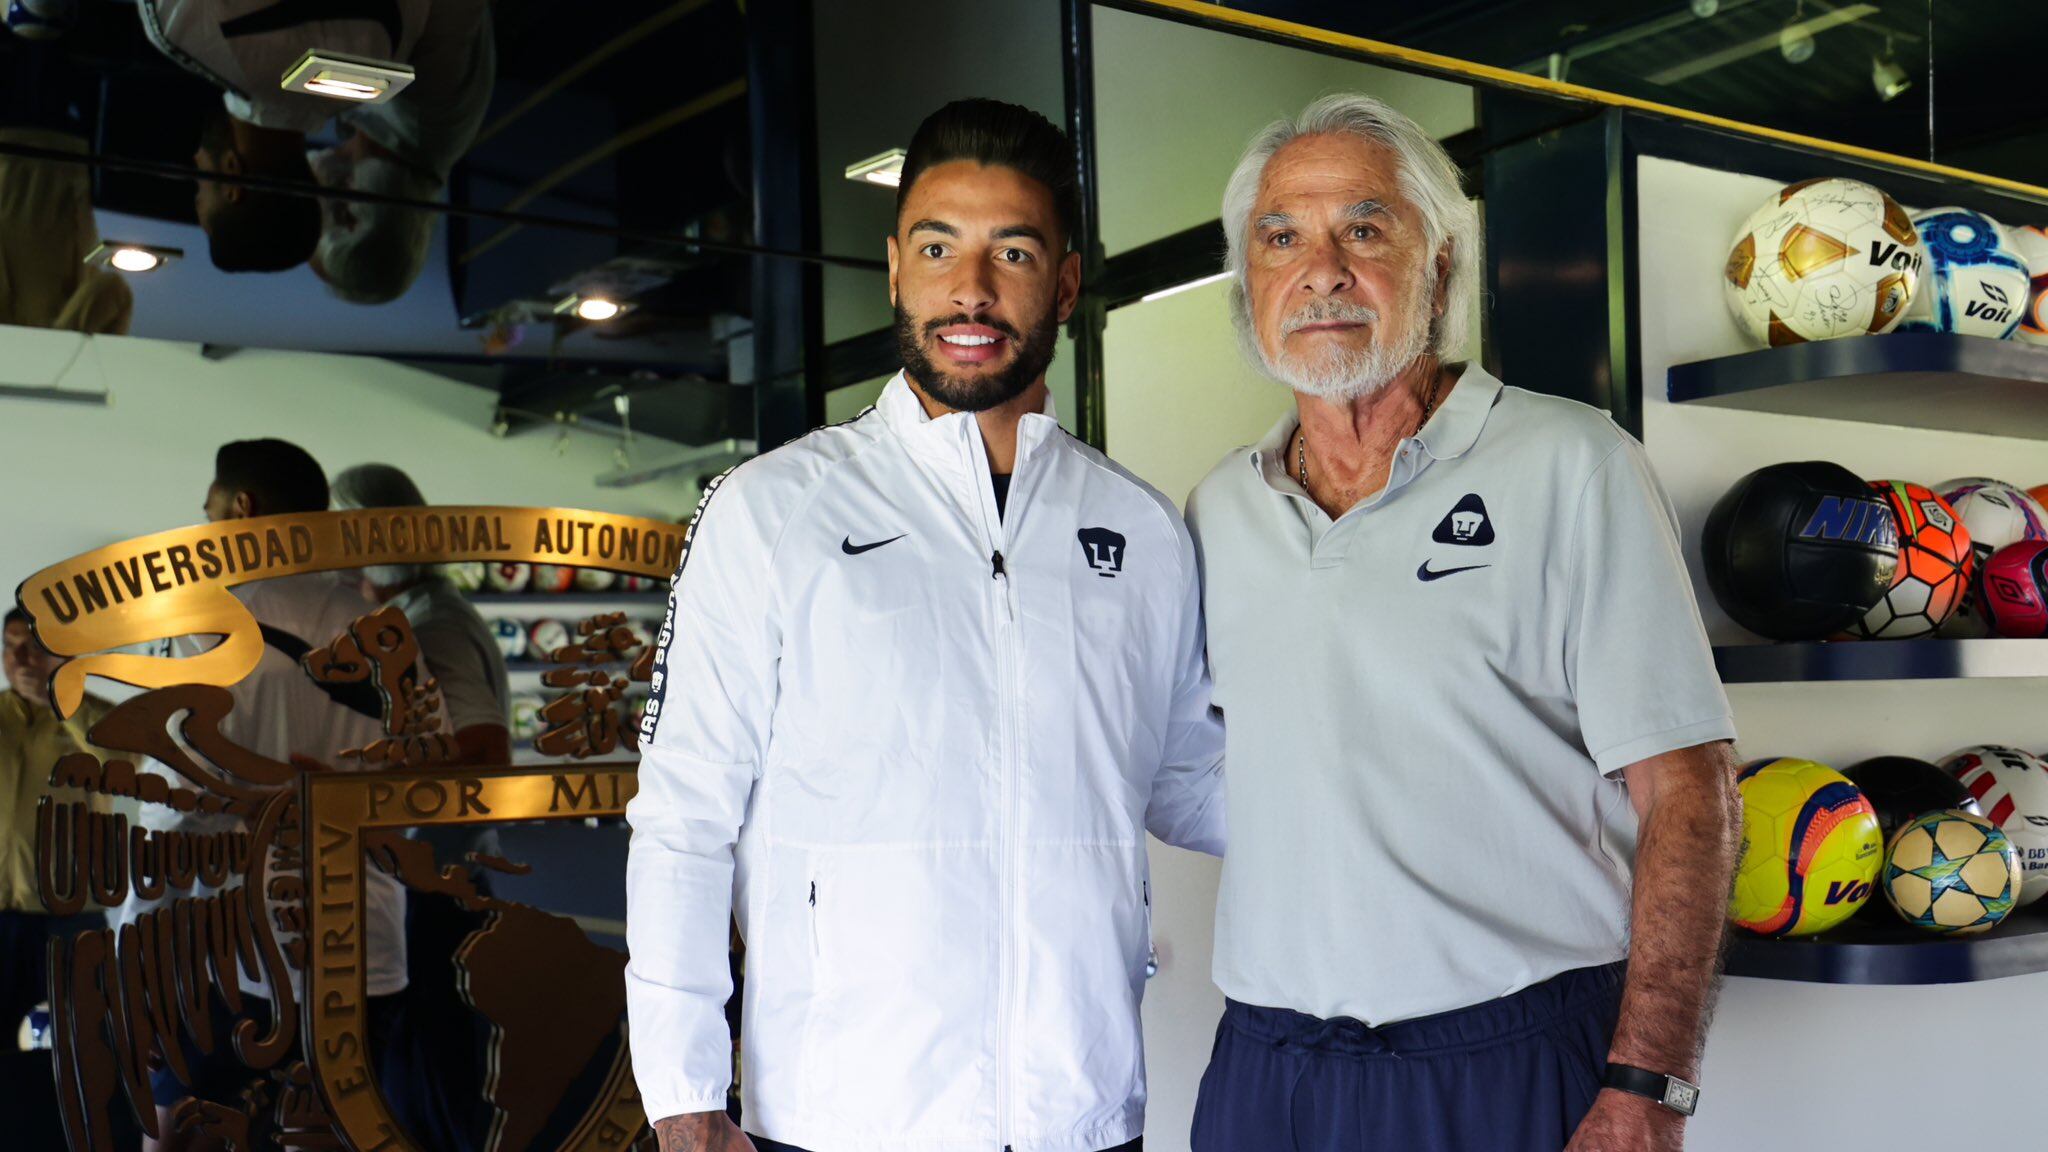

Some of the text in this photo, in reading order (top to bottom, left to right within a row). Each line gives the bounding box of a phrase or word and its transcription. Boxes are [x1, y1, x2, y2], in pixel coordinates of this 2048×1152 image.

[1965, 300, 2012, 323] Voit
[684, 466, 736, 542] PUMA
[41, 525, 314, 625] UNIVERSIDAD
[339, 514, 511, 556] NACIONAL
[367, 774, 622, 821] POR MI
[2028, 847, 2048, 859] BB
[319, 822, 372, 1101] ESPIRITV
